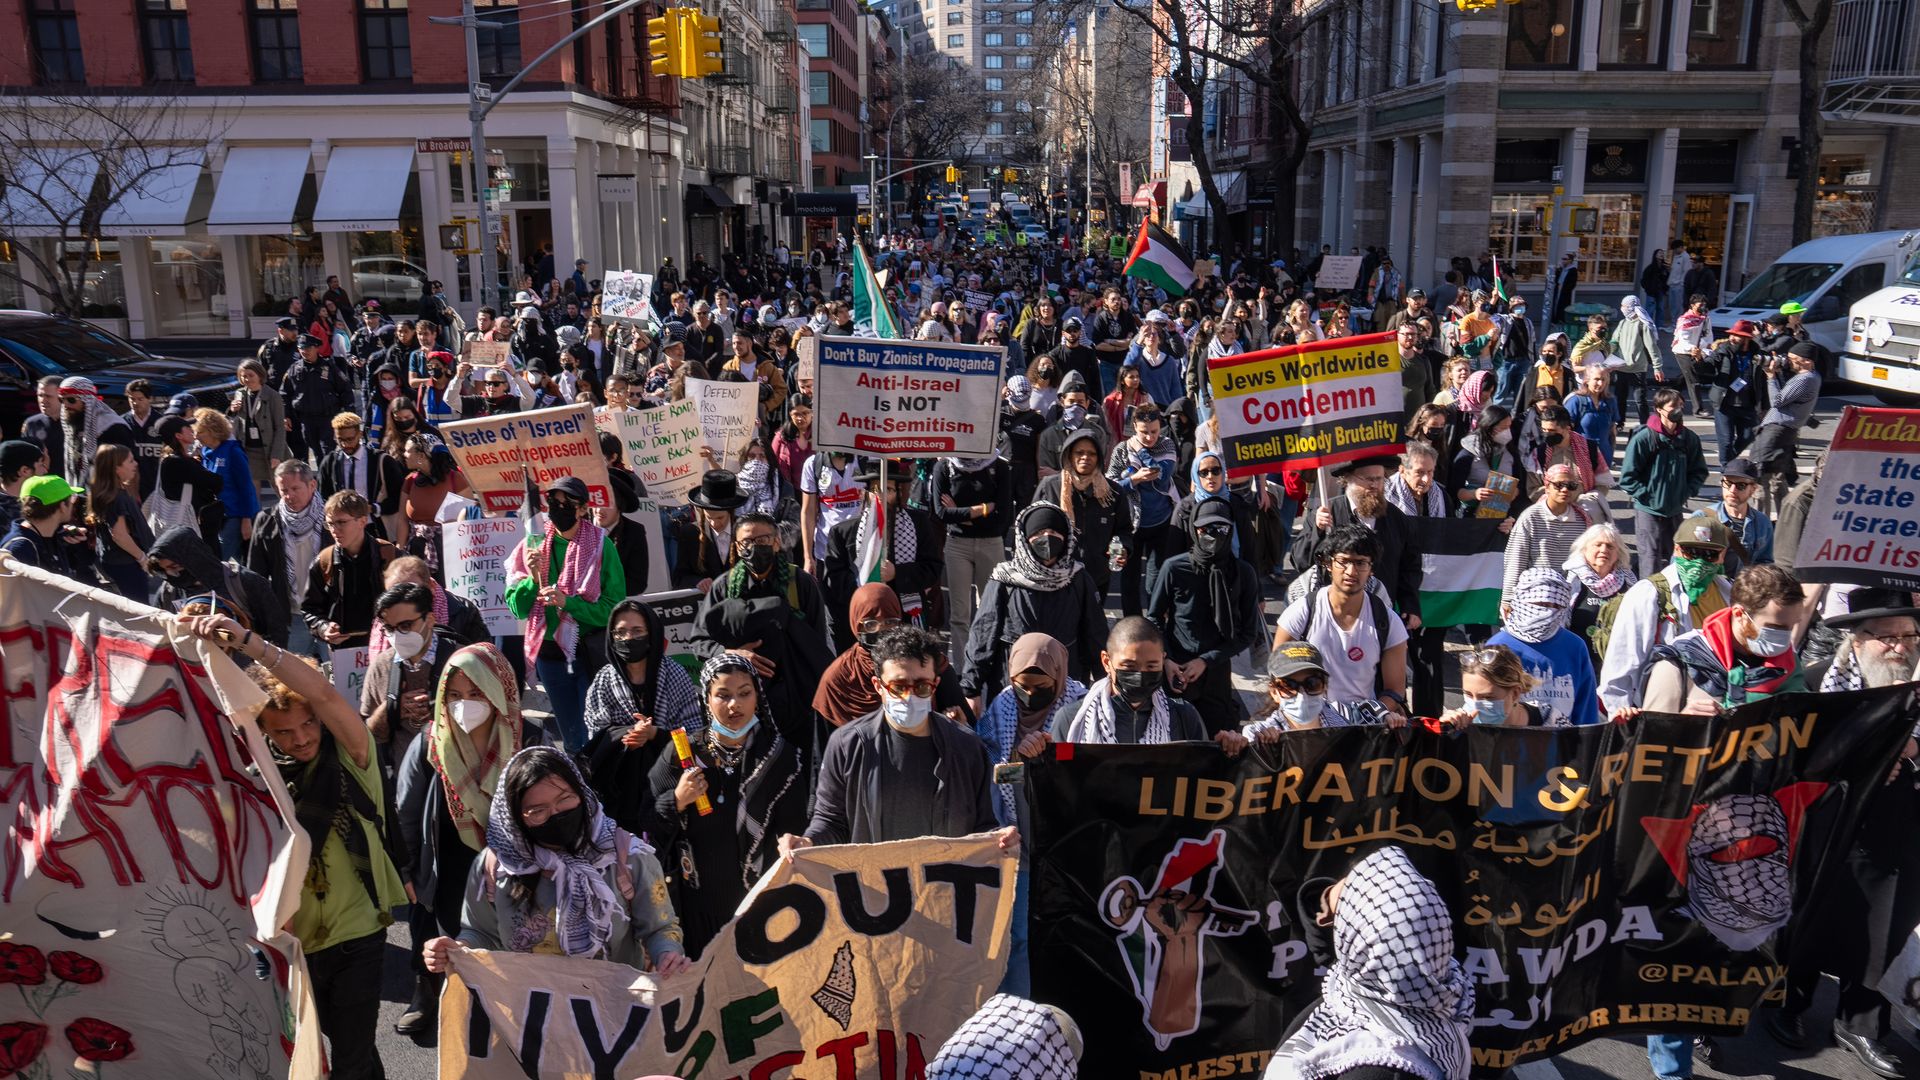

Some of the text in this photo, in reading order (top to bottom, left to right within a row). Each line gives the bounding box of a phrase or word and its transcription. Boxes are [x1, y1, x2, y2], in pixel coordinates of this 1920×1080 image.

[419, 140, 470, 152] W Broadway
[824, 346, 855, 362] Don't
[858, 349, 880, 367] Buy
[882, 350, 924, 367] Zionist
[926, 353, 996, 373] Propaganda
[1222, 350, 1390, 392] Jews Worldwide
[703, 385, 741, 398] DEFEND
[856, 372, 961, 393] Anti-Israel
[874, 396, 941, 412] Is NOT
[1242, 386, 1376, 425] Condemn
[624, 414, 640, 428] HIT
[646, 411, 665, 423] THE
[700, 414, 743, 426] LESTINIAN
[837, 412, 974, 434] Anti-Semitism
[450, 412, 587, 449] State of "Israel"
[628, 440, 646, 451] AND
[680, 426, 699, 442] YOU
[642, 423, 663, 437] ICE
[1235, 419, 1398, 461] Israeli Bloody Brutality
[465, 437, 593, 467] does not represent
[863, 439, 946, 450] www.NKUSA.org
[633, 445, 693, 467] COME BACK
[499, 466, 526, 484] worl
[643, 463, 692, 482] NO MORE
[1880, 457, 1920, 481] the
[1836, 482, 1915, 508] State
[457, 520, 517, 536] STUDENTS
[470, 534, 490, 546] AND
[459, 545, 506, 560] WORKERS
[1814, 538, 1920, 569] And its
[465, 559, 500, 573] UNITE
[460, 575, 480, 586] THE
[486, 572, 507, 583] FIG
[467, 585, 488, 598] FOR
[652, 604, 694, 618] Free
[1138, 713, 1819, 821] LIBERATION & RETURN
[735, 862, 1001, 965] OUT
[1556, 1007, 1610, 1045] FOR
